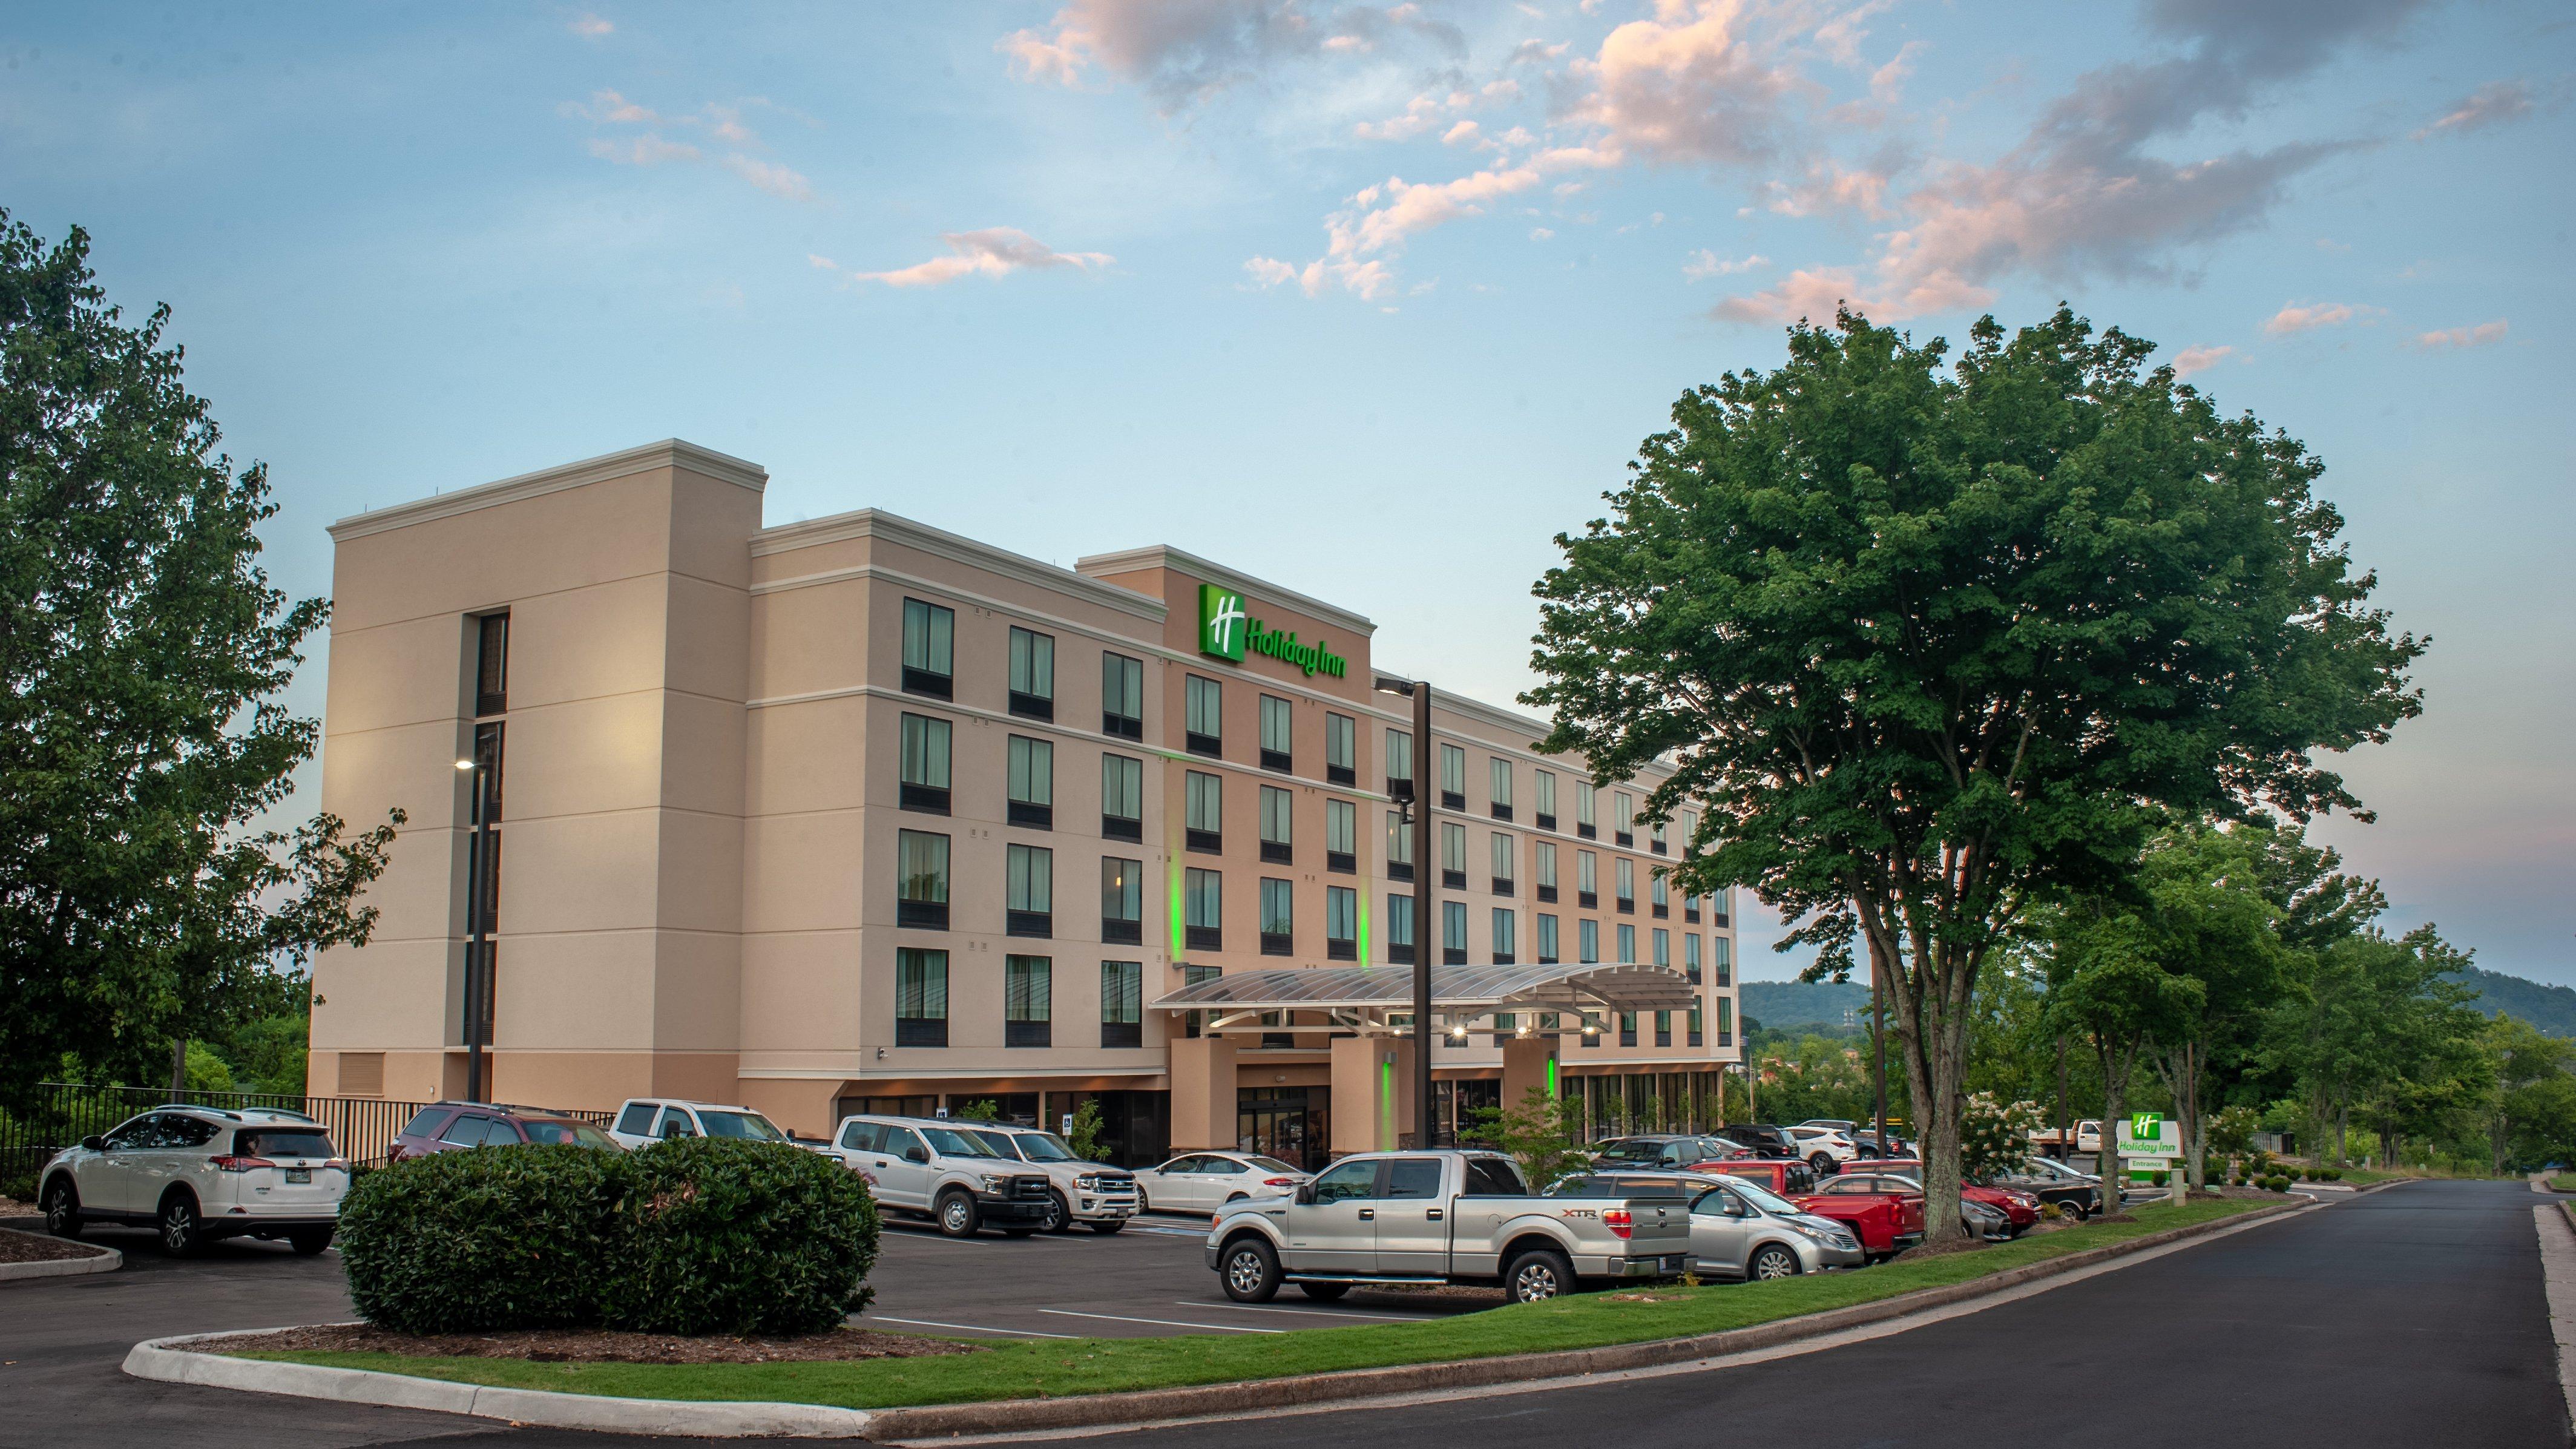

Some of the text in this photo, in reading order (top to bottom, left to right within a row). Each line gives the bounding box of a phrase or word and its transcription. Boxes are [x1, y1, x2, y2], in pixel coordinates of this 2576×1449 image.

[1246, 617, 1347, 678] Holiday Inn
[2120, 1141, 2176, 1154] Holiday Inn
[1562, 1209, 1597, 1217] XTR
